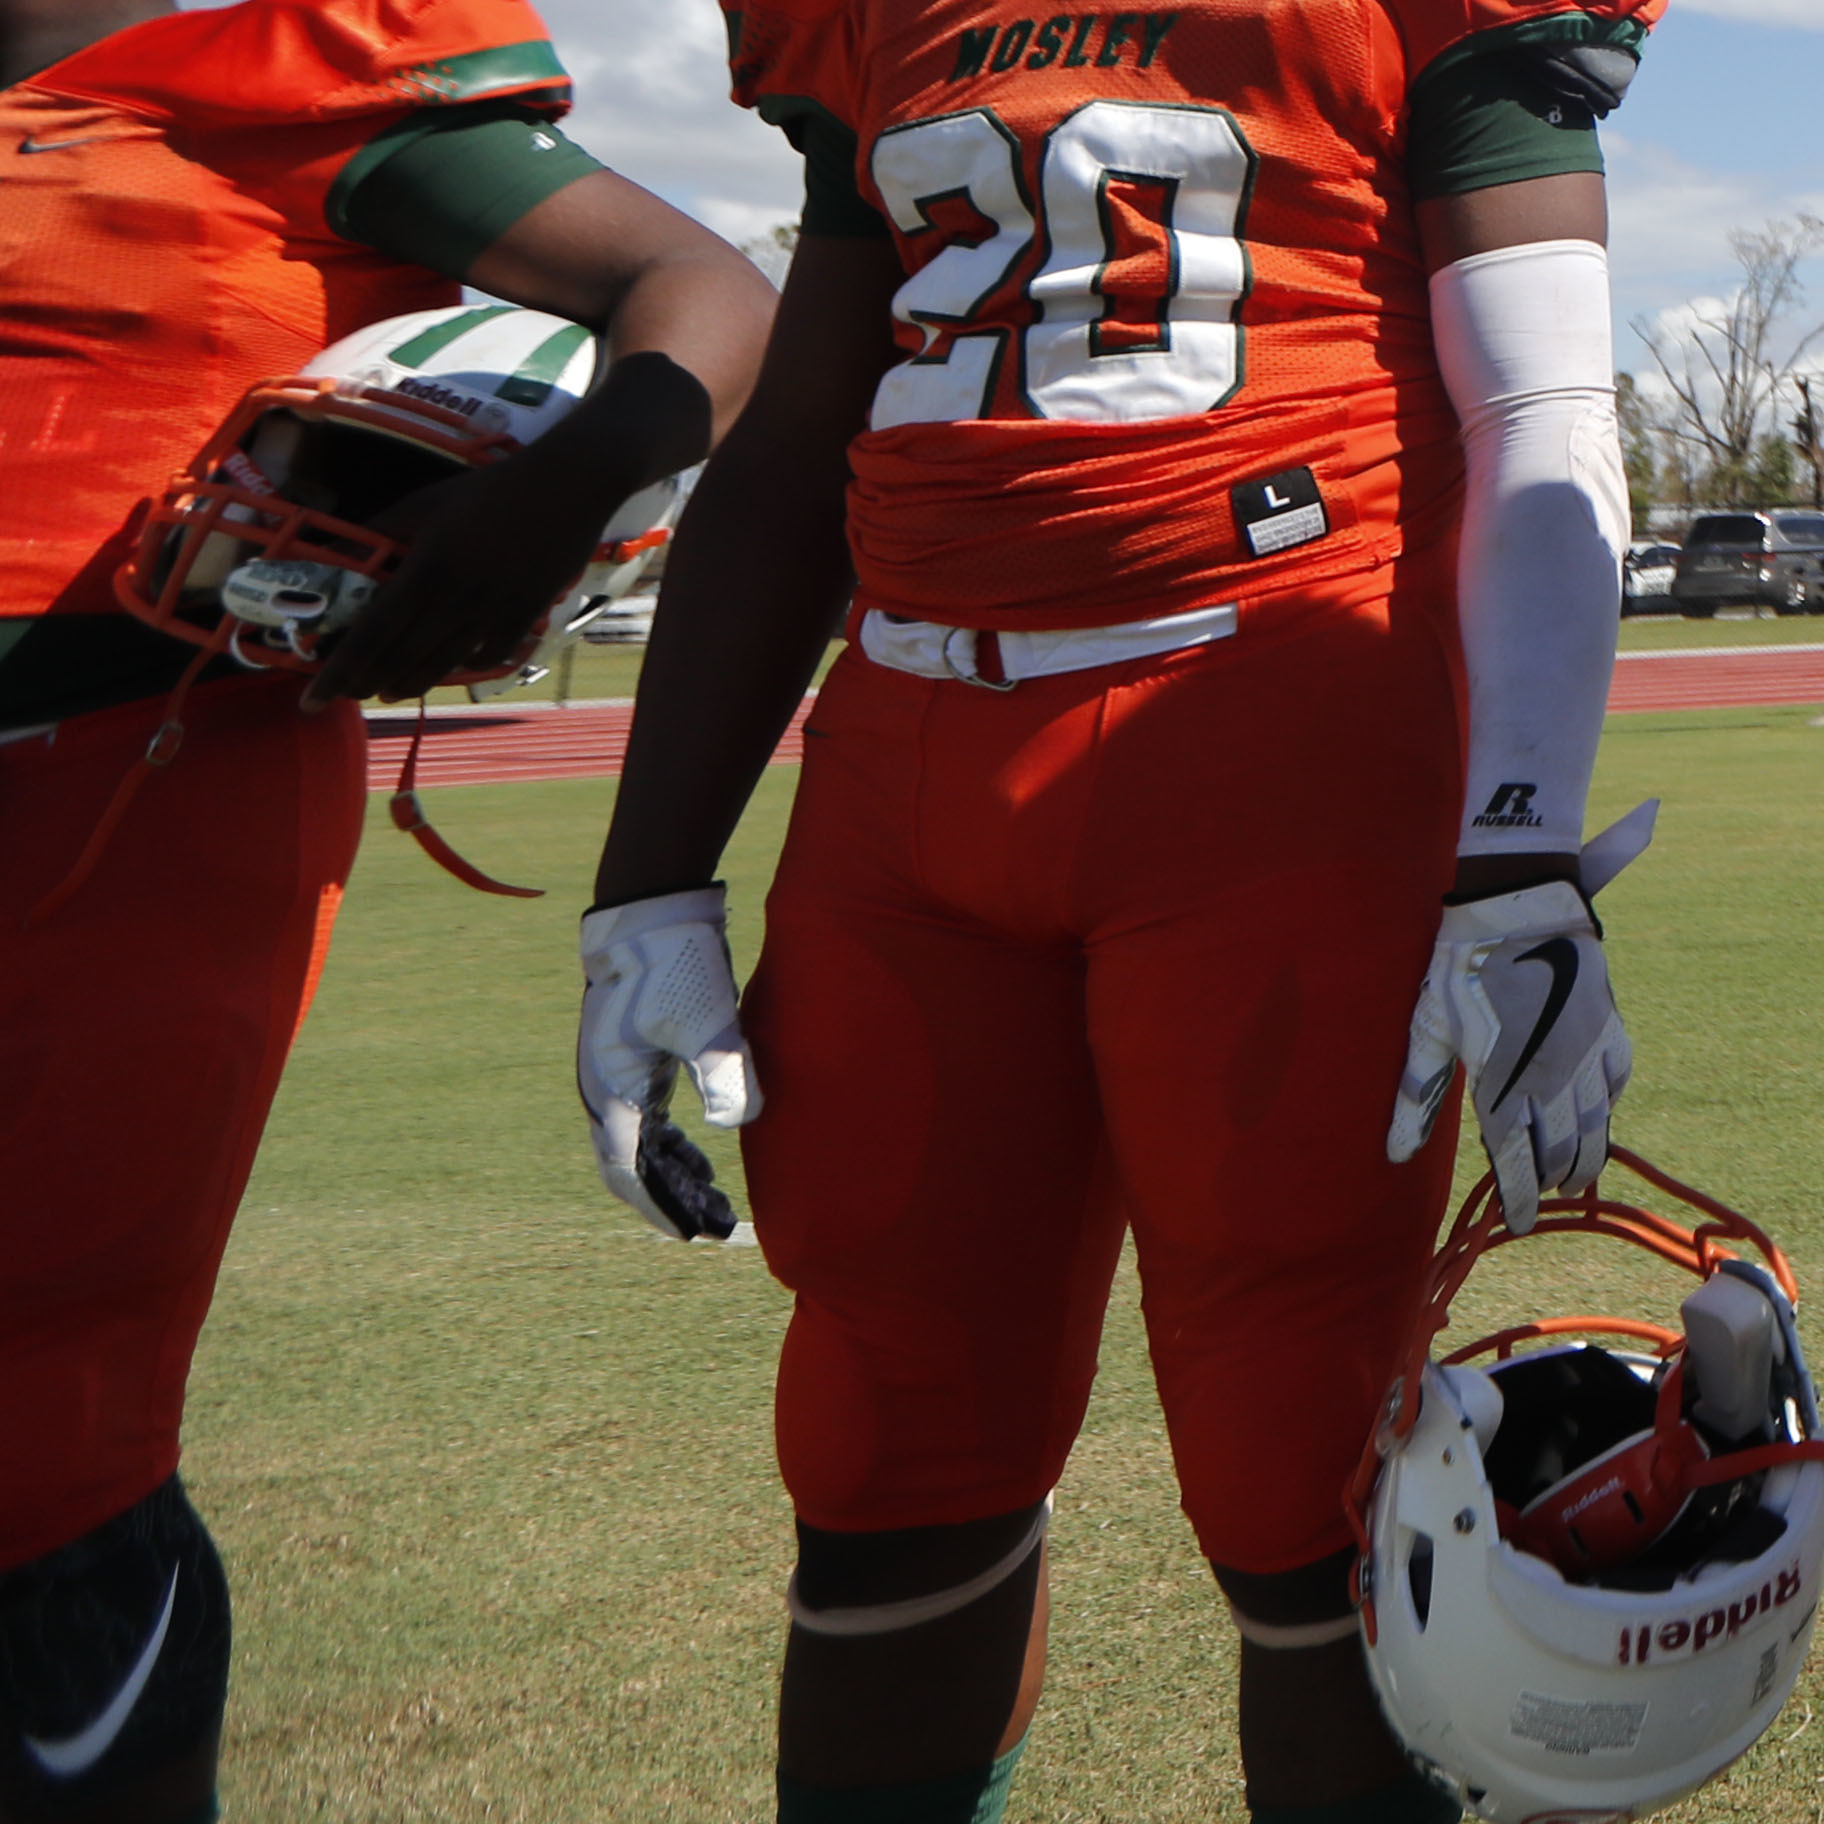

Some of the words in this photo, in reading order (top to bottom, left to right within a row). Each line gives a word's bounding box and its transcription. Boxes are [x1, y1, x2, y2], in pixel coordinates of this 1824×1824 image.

[948, 12, 1180, 81] MOSLEY
[870, 99, 1259, 431] 20
[1263, 485, 1291, 509] L
[1471, 815, 1544, 827] RUSSELL
[1619, 1566, 1802, 1667] Riddell
